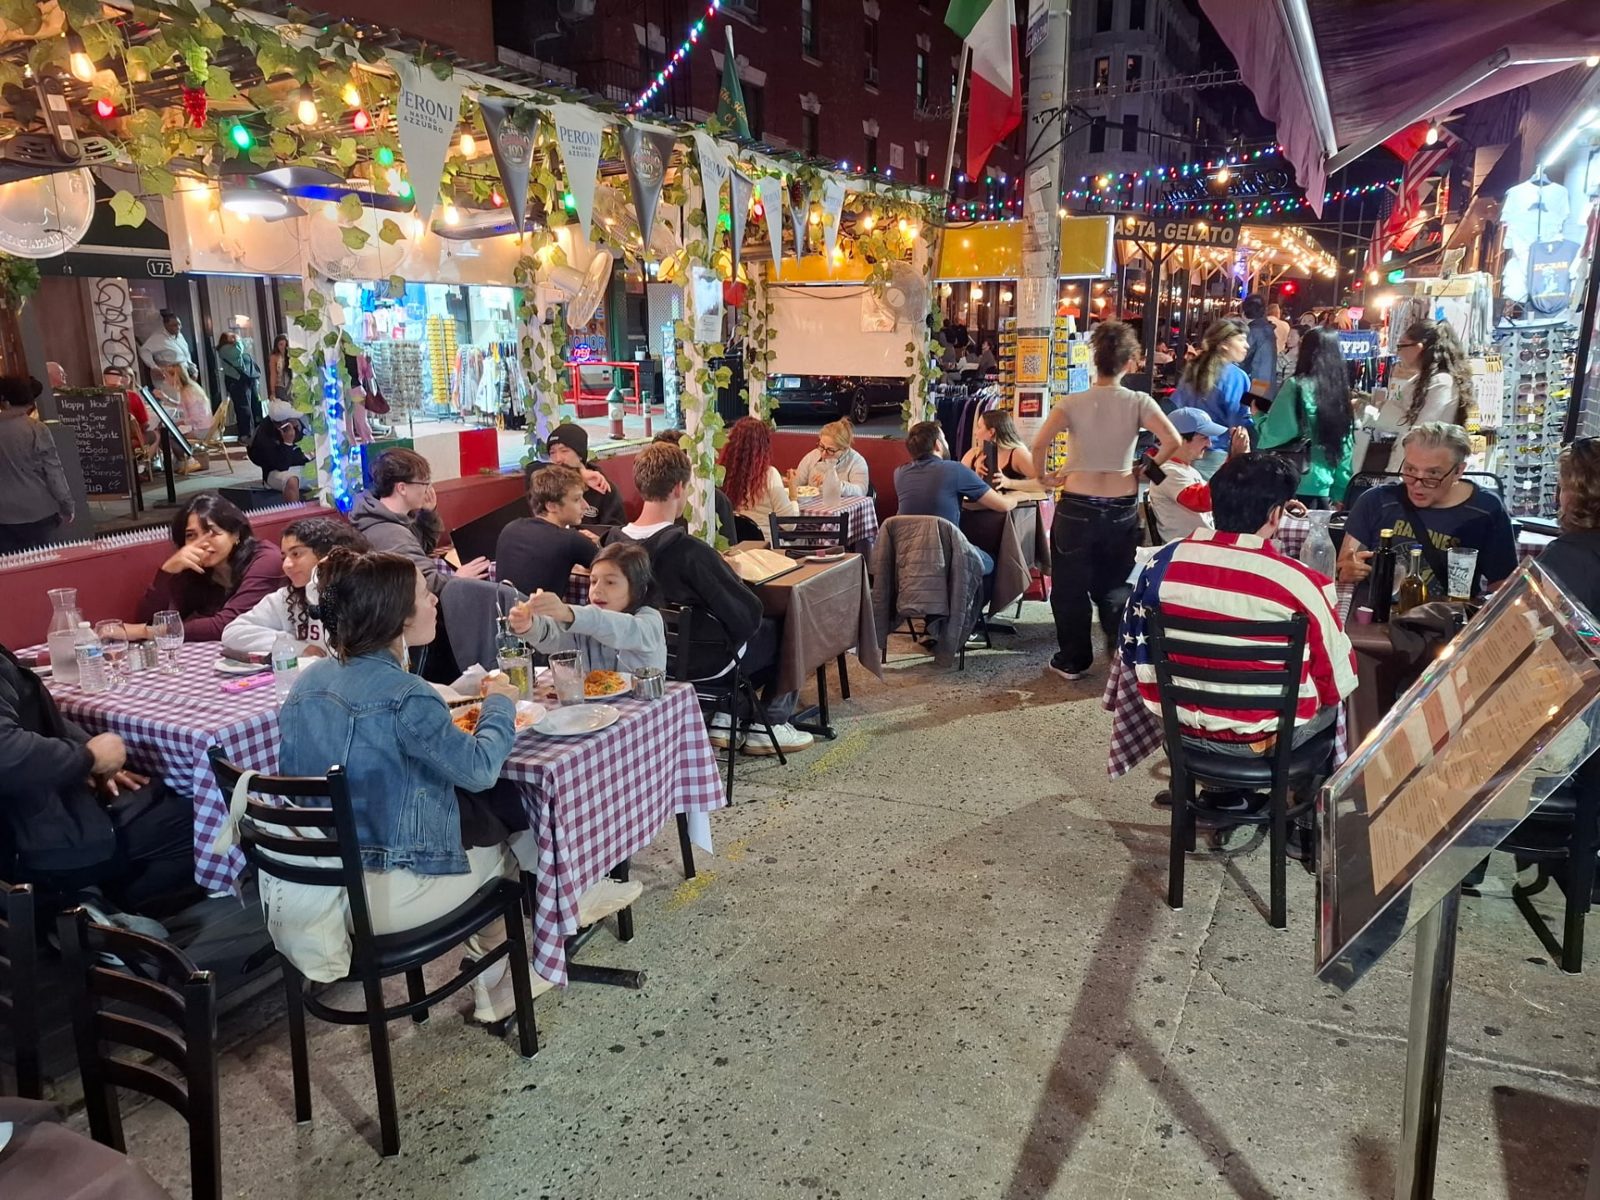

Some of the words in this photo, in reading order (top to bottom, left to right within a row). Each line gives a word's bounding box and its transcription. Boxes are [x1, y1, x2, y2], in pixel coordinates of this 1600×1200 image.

[403, 115, 444, 135] AZZURRO
[409, 110, 438, 125] NASTRO
[559, 125, 600, 147] PERONI
[508, 143, 524, 157] 100
[1113, 219, 1156, 238] ASTA
[1163, 222, 1234, 244] GELATO
[150, 262, 173, 275] 173
[1339, 340, 1370, 354] YPD
[61, 400, 84, 411] Happy
[90, 399, 109, 409] Hour
[1393, 519, 1461, 552] RANES
